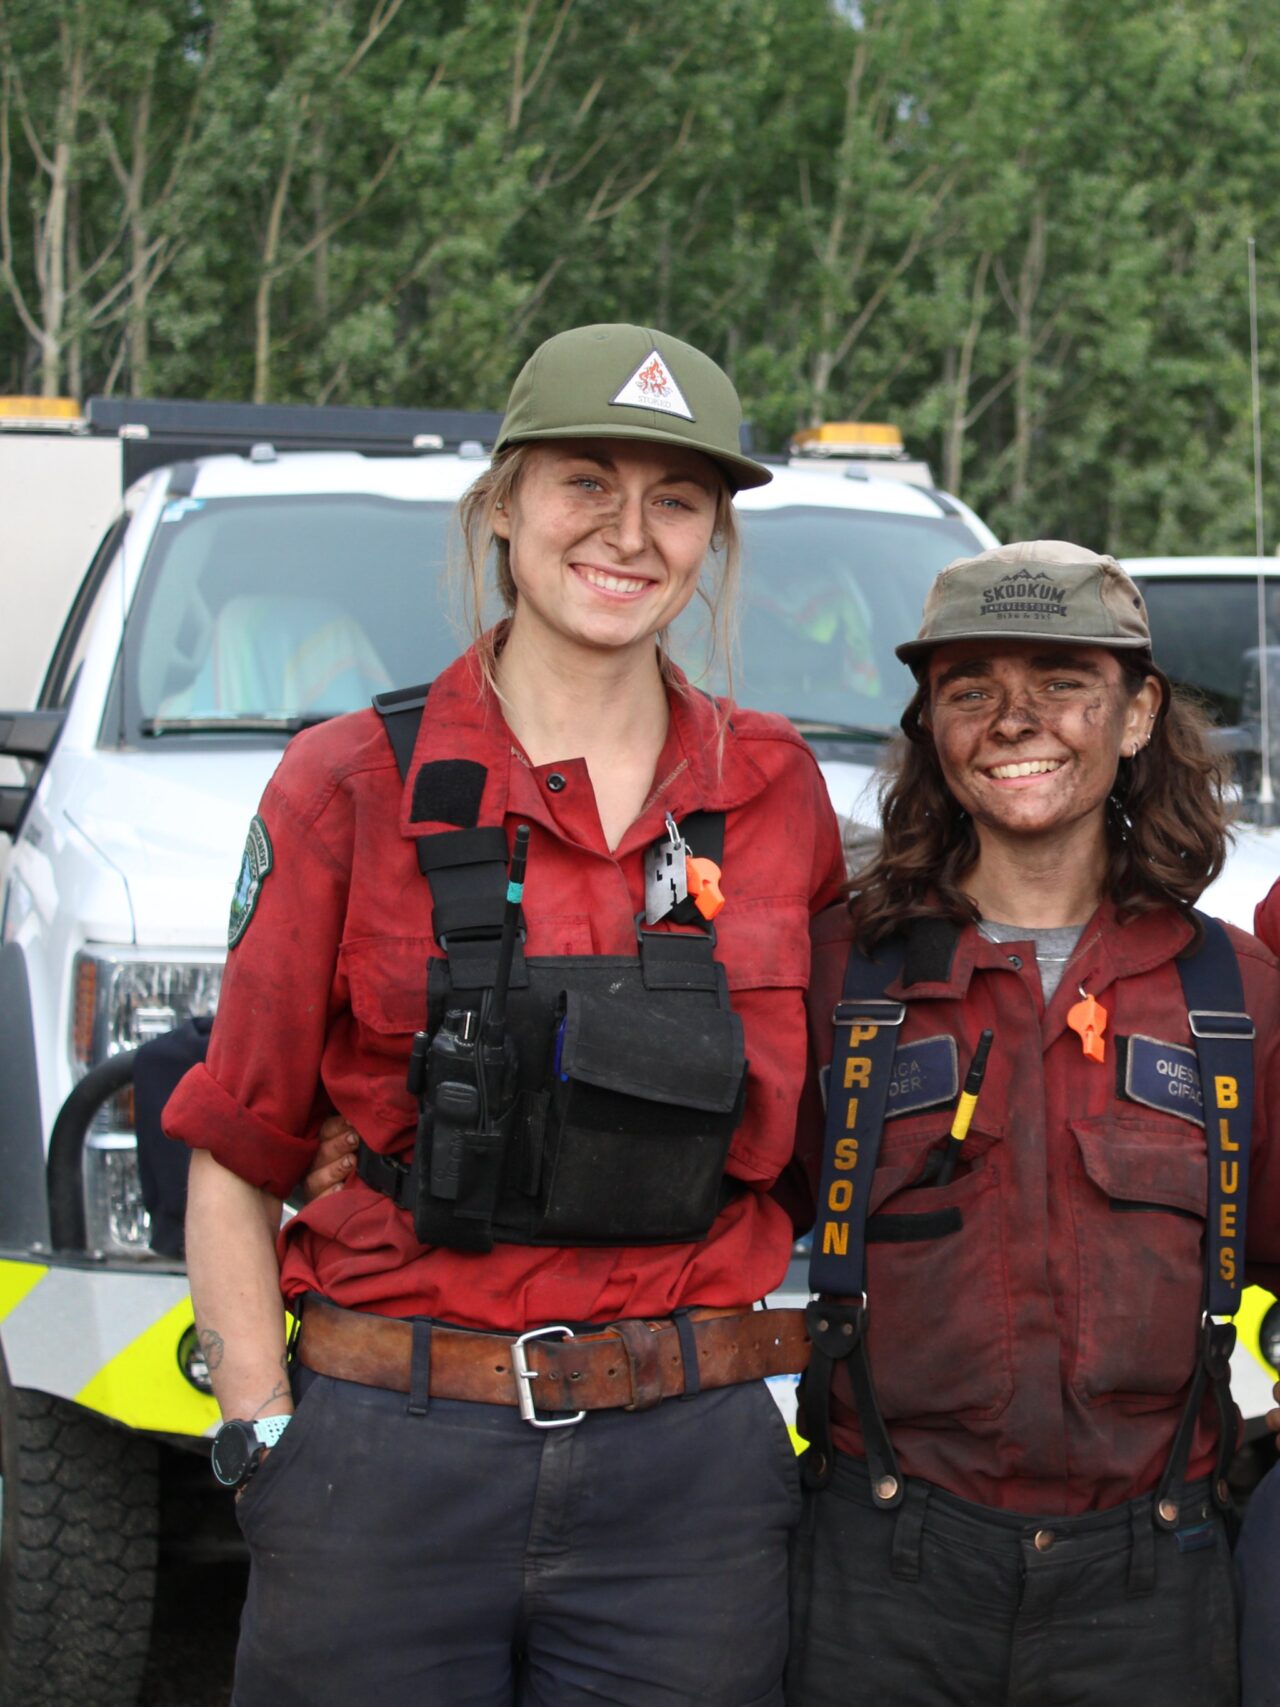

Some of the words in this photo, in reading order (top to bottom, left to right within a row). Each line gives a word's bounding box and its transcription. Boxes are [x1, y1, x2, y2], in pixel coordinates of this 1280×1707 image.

[983, 583, 1067, 604] SKOOKUM
[1156, 1059, 1200, 1086] QUES
[821, 1017, 879, 1257] PRISON
